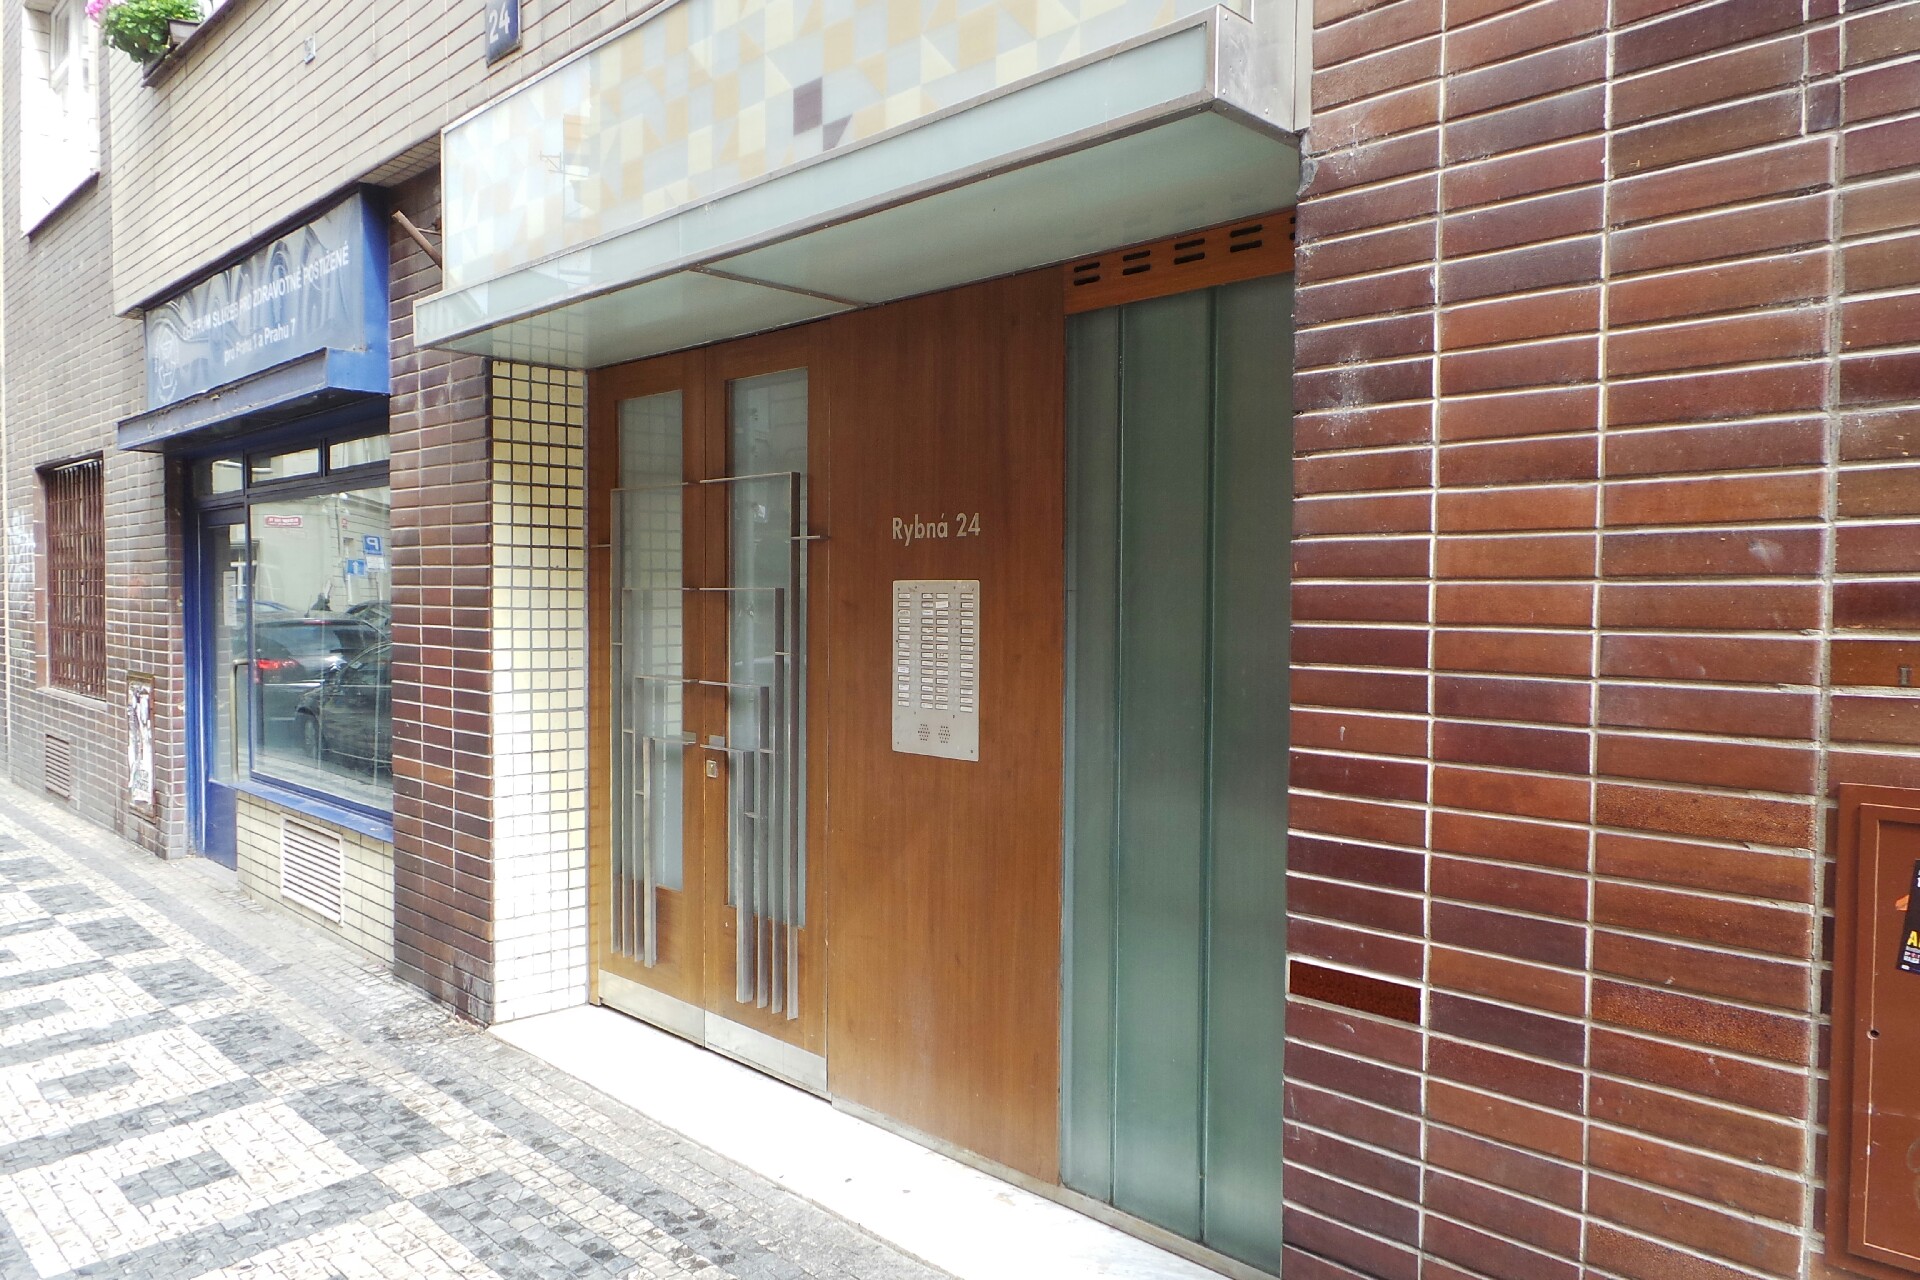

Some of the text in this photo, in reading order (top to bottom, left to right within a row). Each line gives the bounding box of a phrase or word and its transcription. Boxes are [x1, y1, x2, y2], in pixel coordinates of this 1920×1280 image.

[489, 2, 510, 43] 24
[239, 294, 252, 315] PRO
[224, 347, 236, 367] pro
[258, 334, 264, 348] a
[264, 323, 289, 345] Prahu
[290, 317, 296, 337] 7
[892, 512, 981, 546] Rybná 24
[1907, 930, 1920, 948] A
